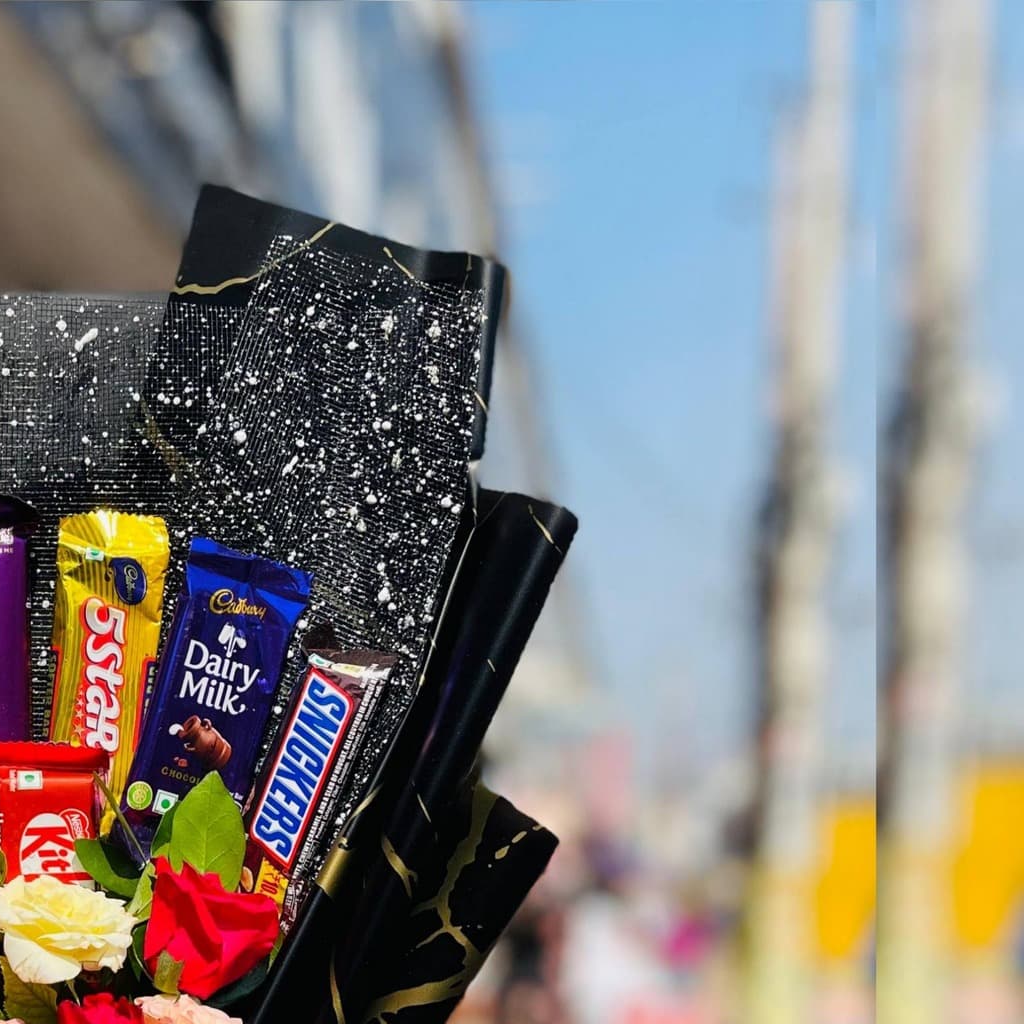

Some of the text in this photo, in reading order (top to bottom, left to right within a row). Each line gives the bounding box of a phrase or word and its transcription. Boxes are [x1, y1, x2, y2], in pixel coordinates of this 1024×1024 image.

[210, 588, 266, 620] Cadbury
[184, 639, 260, 693] Dairy
[179, 671, 246, 715] Milk
[347, 712, 363, 740] COVERED
[254, 678, 347, 859] SNICKERS
